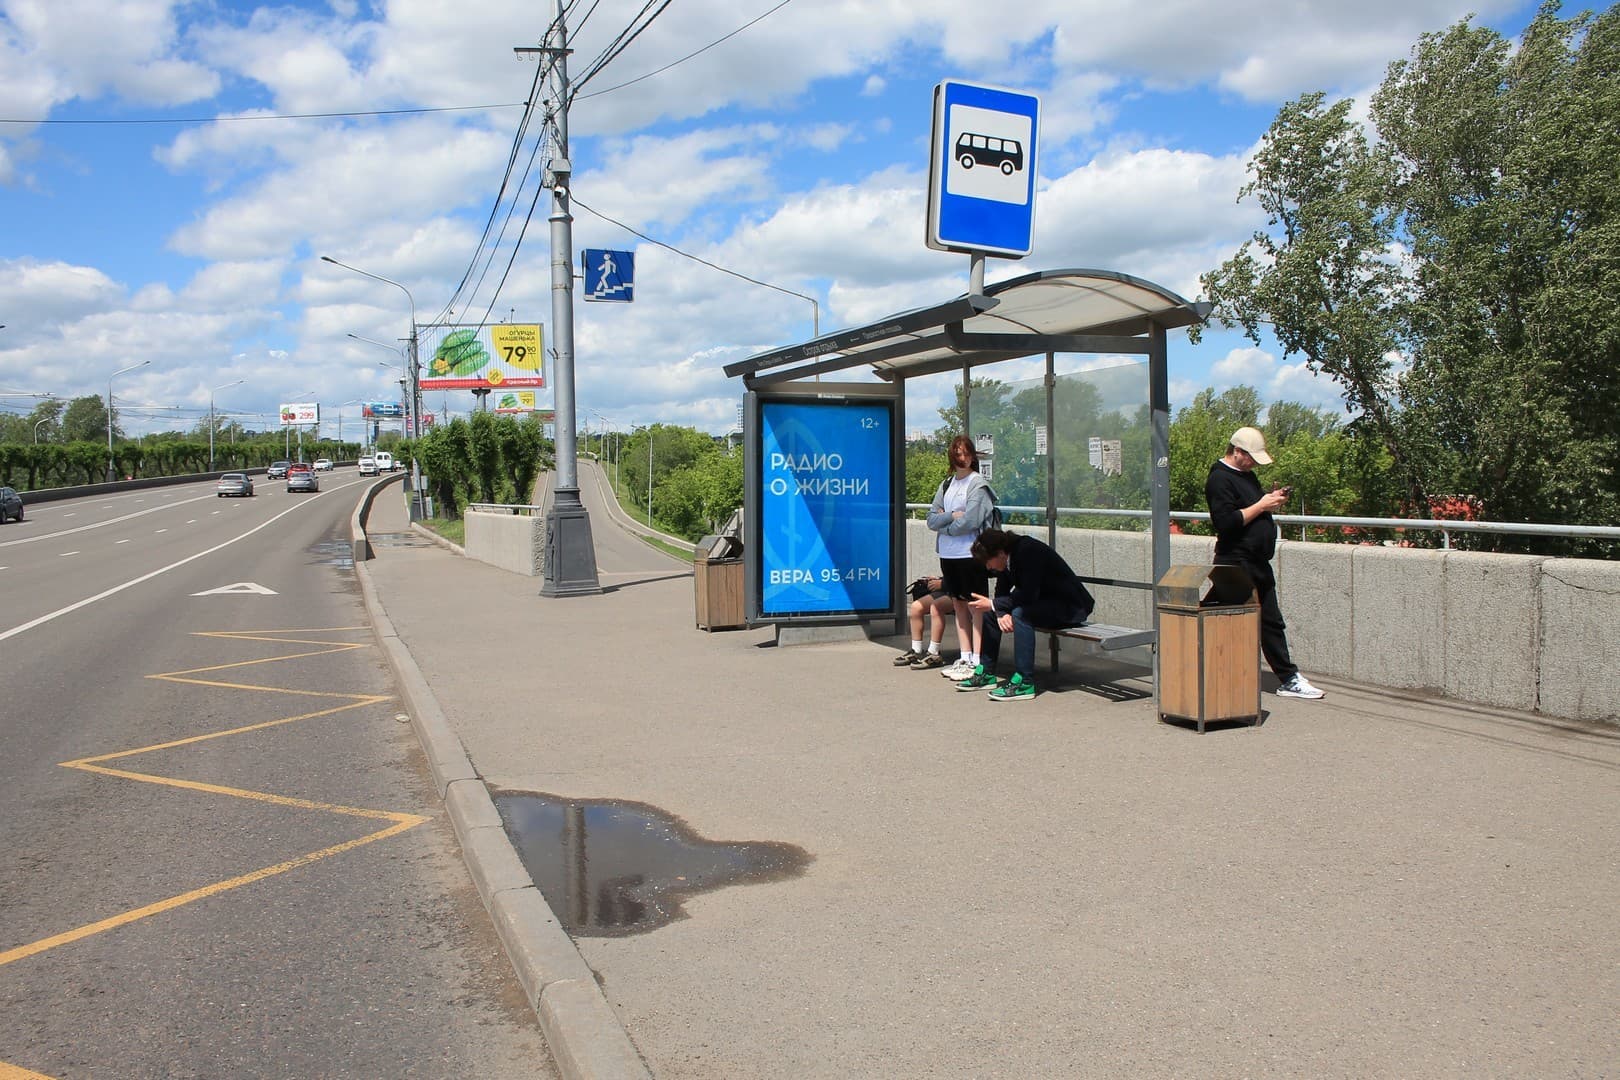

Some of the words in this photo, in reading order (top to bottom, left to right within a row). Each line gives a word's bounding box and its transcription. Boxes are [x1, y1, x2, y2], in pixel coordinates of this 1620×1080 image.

[503, 346, 526, 362] 79
[860, 418, 880, 428] 12+
[771, 453, 843, 473] РАДИО
[770, 478, 787, 496] О
[794, 478, 869, 495] ЖИЗНИ
[770, 570, 814, 584] ВЕРА
[820, 568, 855, 582] 95.4
[858, 568, 880, 581] FM
